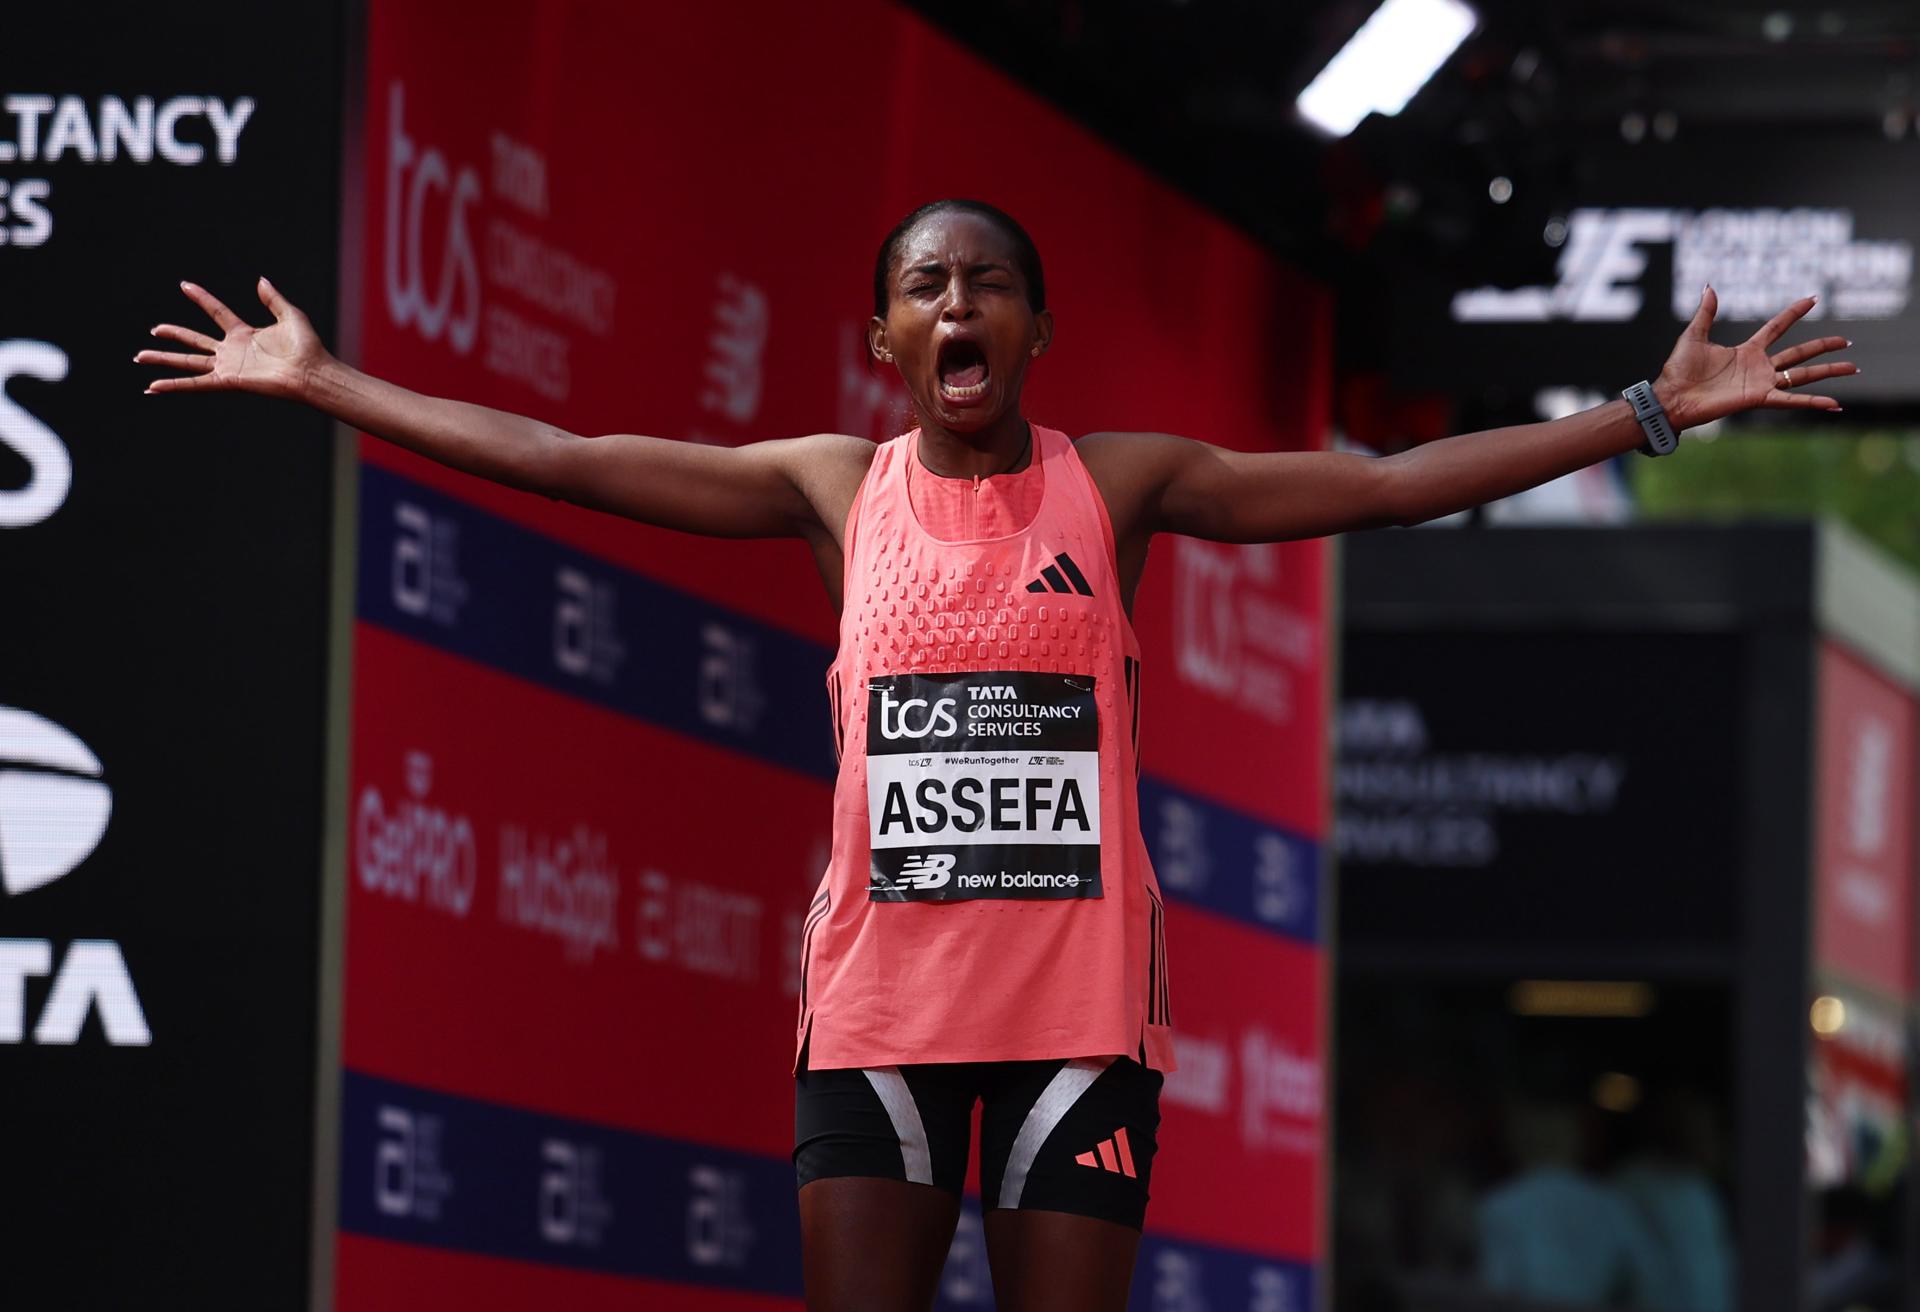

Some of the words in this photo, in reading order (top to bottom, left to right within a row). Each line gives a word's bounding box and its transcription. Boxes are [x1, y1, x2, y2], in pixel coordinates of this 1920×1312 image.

[0, 177, 53, 247] S
[385, 79, 482, 355] tcs
[968, 685, 1017, 700] TATA
[880, 691, 958, 740] tcs
[967, 704, 1081, 719] CONSULTANCY
[967, 721, 1042, 737] SERVICES
[944, 756, 1019, 766] #WeRunTogether
[879, 778, 1091, 835] ASSEFA
[957, 873, 997, 888] new
[1001, 871, 1079, 888] balance
